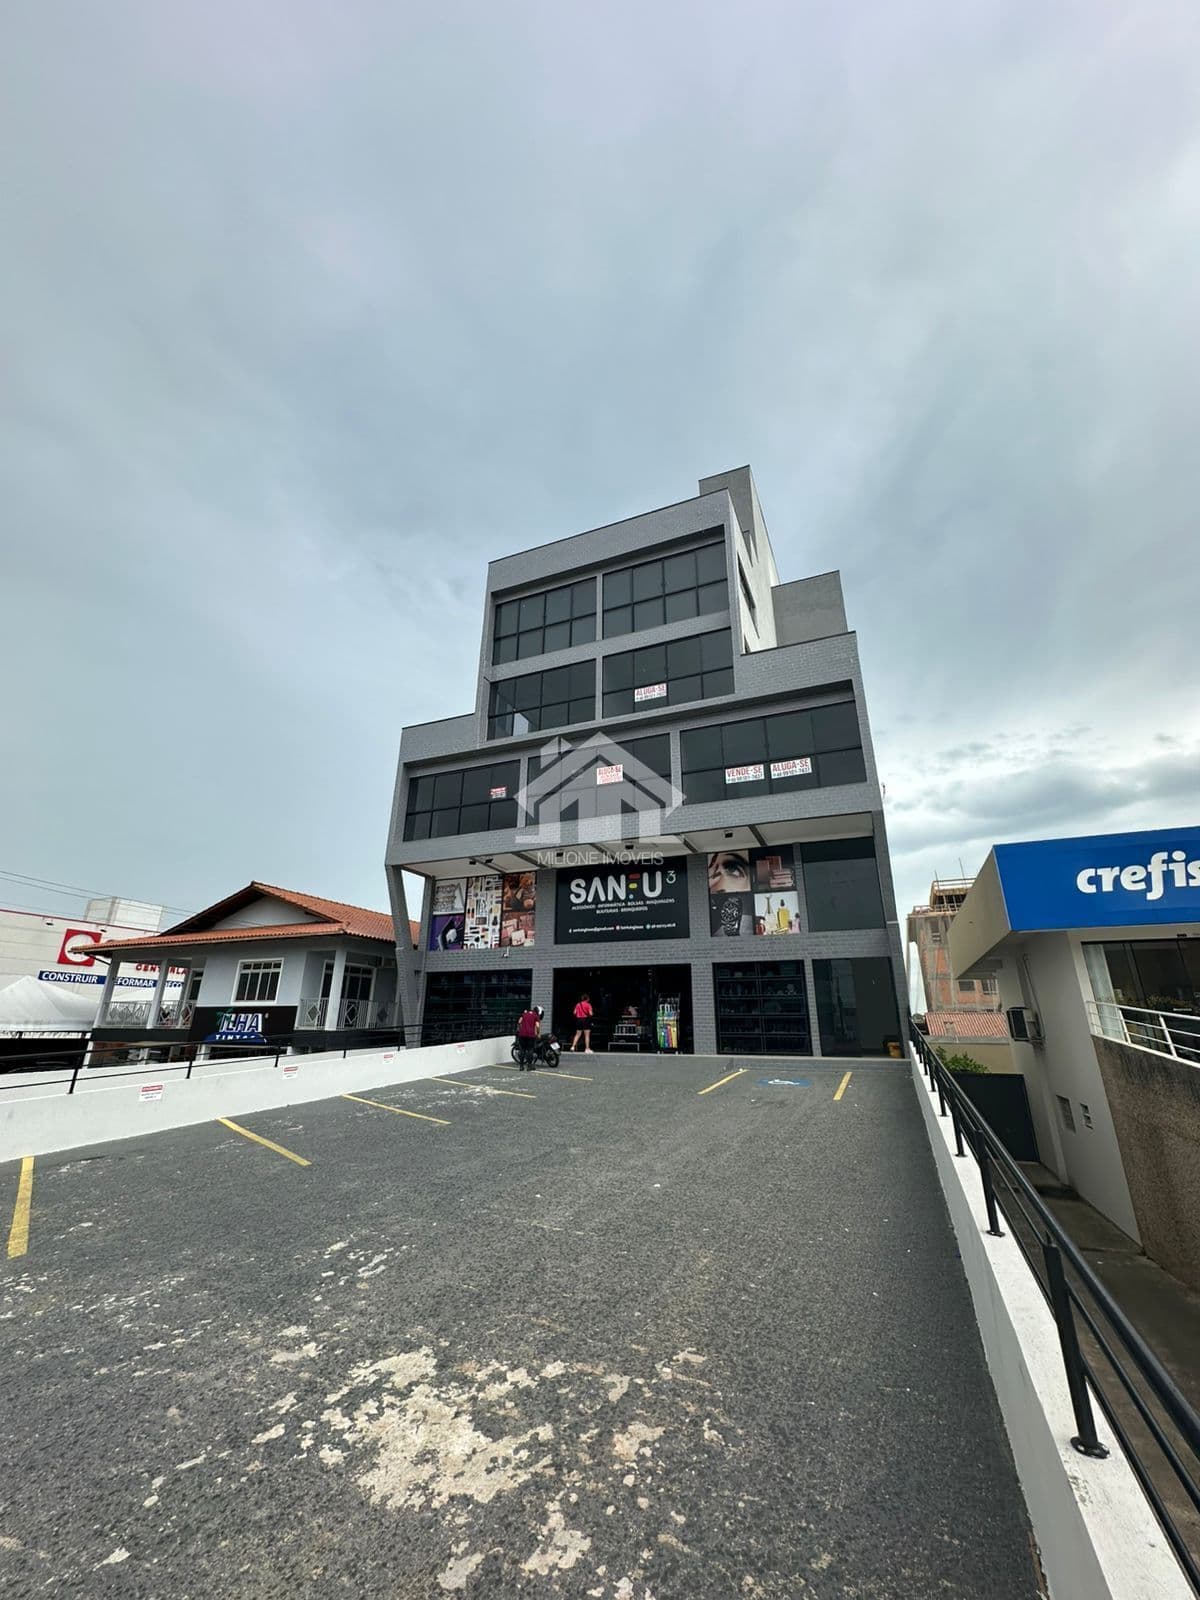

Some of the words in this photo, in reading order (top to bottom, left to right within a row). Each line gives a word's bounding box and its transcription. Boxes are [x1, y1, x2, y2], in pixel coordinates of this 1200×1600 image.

[727, 766, 762, 778] VENDE-SE
[772, 758, 809, 772] ALUGA-SE
[1076, 850, 1200, 901] crefis
[42, 972, 98, 984] CONSTRUIR
[115, 977, 154, 987] FORMAR
[219, 1013, 263, 1033] ILHA
